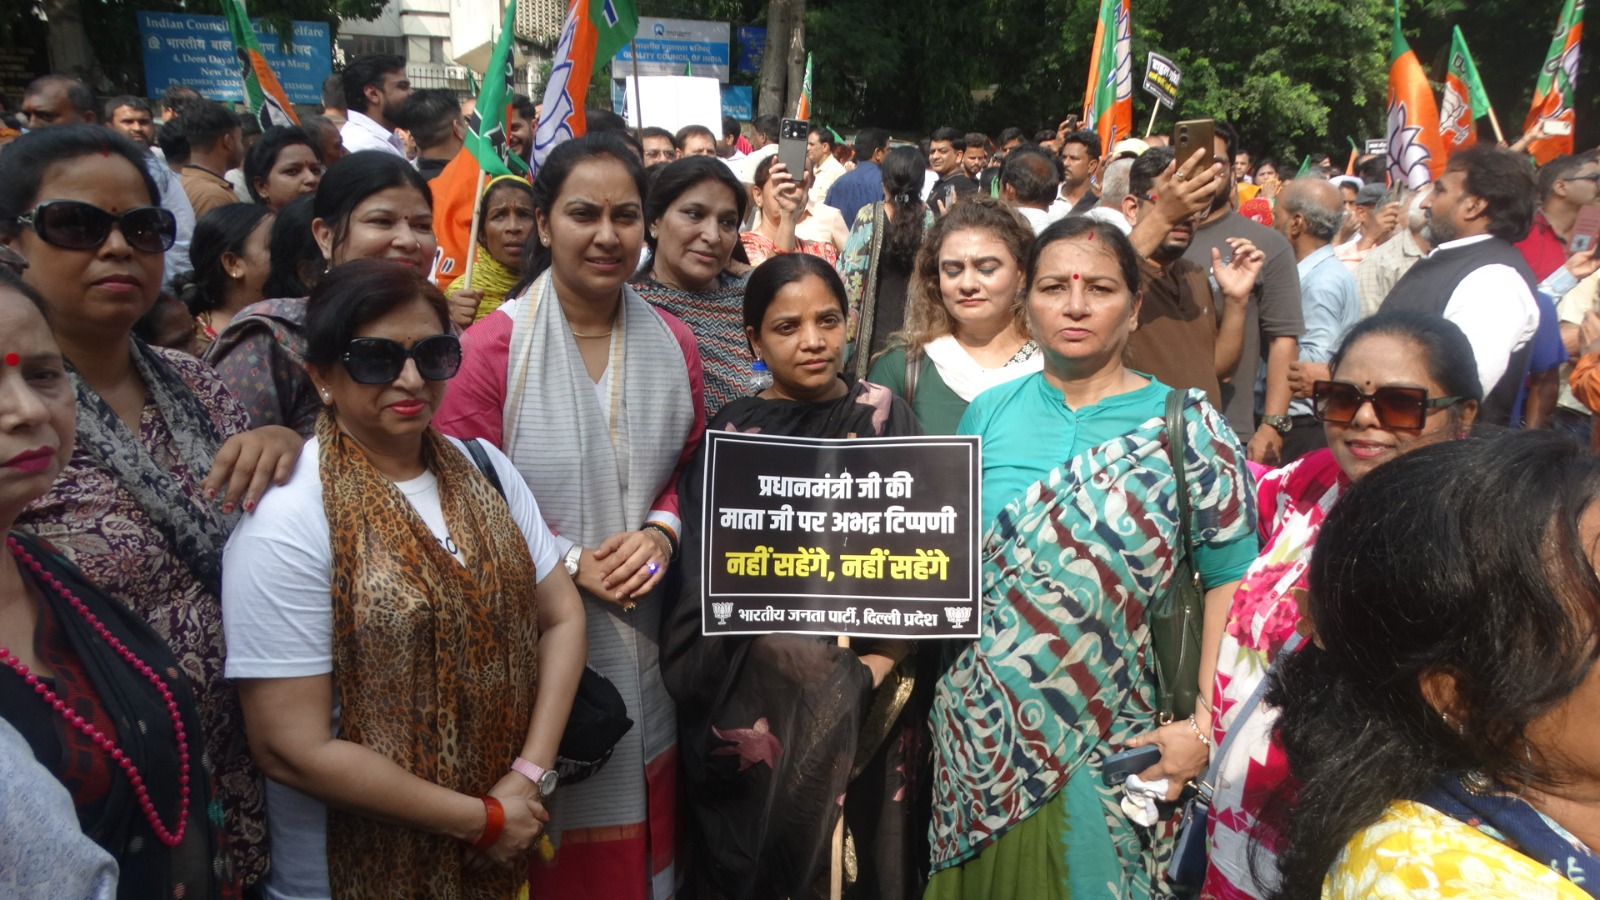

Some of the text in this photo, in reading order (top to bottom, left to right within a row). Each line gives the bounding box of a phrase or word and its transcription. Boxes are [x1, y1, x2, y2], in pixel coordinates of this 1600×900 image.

[145, 16, 184, 29] Indian
[186, 19, 231, 31] Council
[292, 26, 324, 37] elfare
[165, 36, 206, 50] भारतीय
[656, 52, 689, 62] COUNCIL
[691, 54, 701, 62] OF
[702, 55, 723, 63] INDIA
[201, 67, 222, 76] New
[758, 470, 914, 499] प्रधानमंत्री जी की
[719, 504, 957, 535] माता जी पर अभद्र टिप्पणी
[725, 544, 950, 582] नहीं सहेंगे, नहीं सहेंगे
[738, 605, 938, 627] भारतीय जनता पार्टी, दिल्ली प्रदेश
